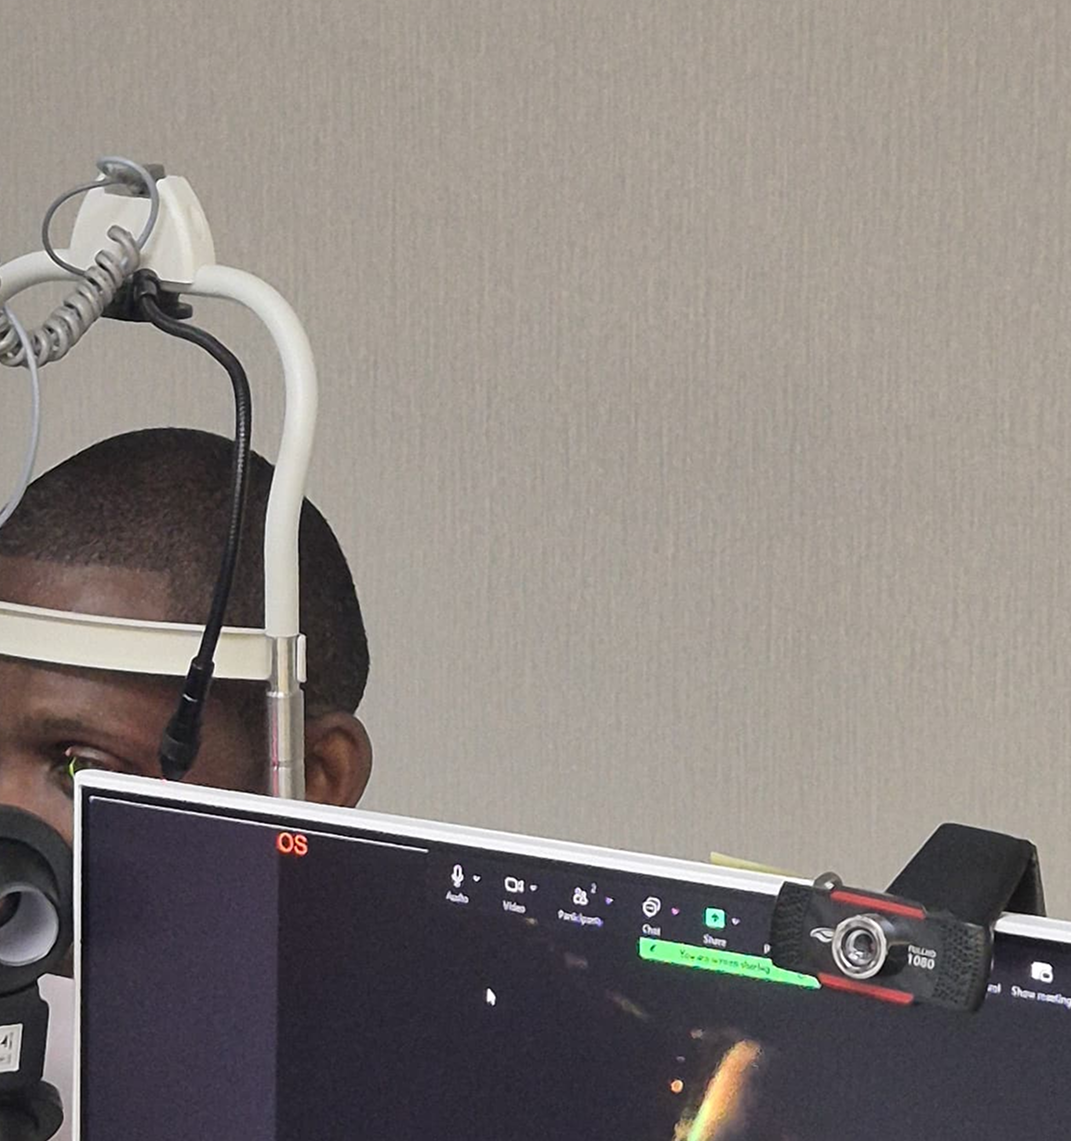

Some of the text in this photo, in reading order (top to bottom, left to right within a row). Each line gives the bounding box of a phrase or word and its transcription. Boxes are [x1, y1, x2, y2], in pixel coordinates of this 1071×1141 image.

[278, 832, 308, 855] OS
[446, 891, 469, 904] Audio
[503, 900, 526, 914] Video
[642, 923, 661, 937] Chat
[703, 934, 727, 948] Share
[908, 952, 935, 970] 1080
[1011, 985, 1036, 999] Show
